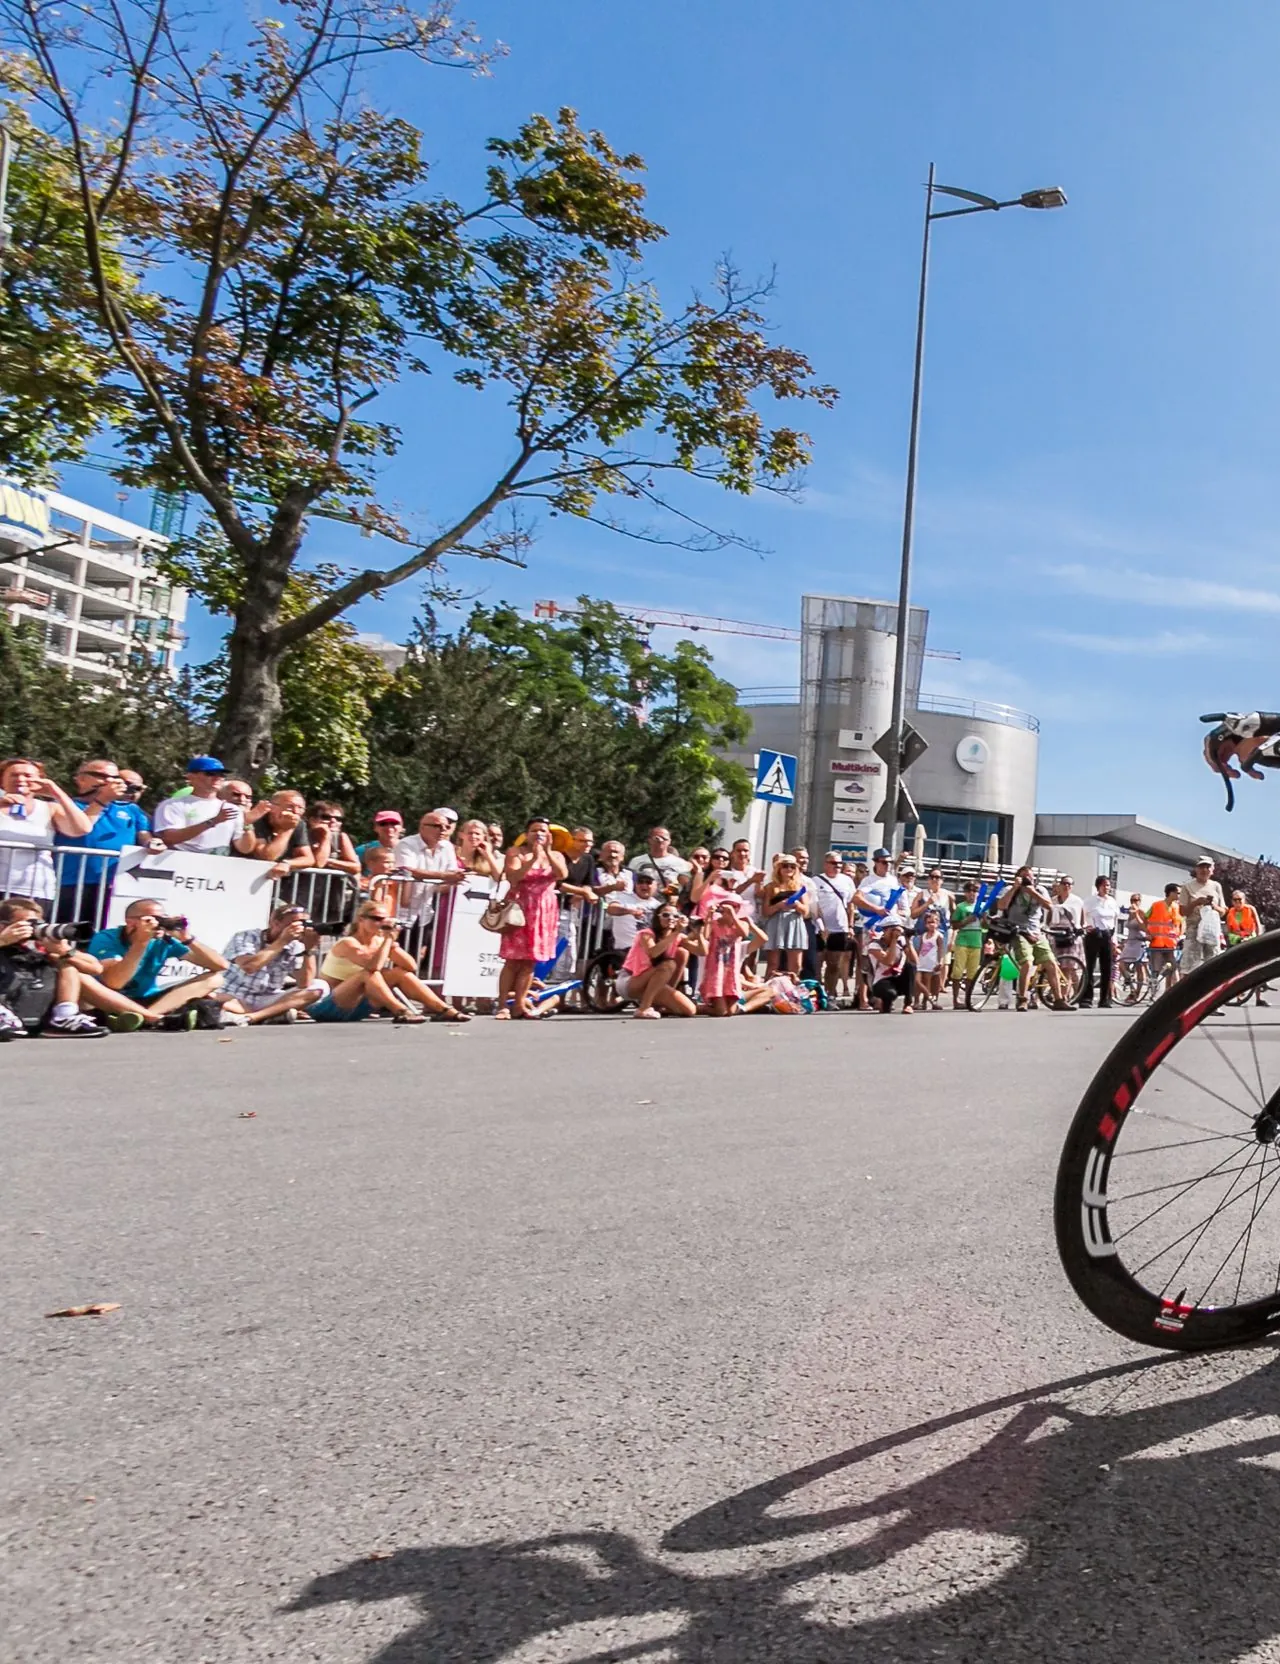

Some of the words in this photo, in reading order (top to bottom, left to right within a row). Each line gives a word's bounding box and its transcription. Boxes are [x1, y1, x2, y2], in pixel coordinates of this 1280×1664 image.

[831, 762, 880, 774] Multikino
[174, 875, 226, 892] PĘTLA
[479, 953, 499, 963] STR
[158, 964, 209, 977] ZMIA
